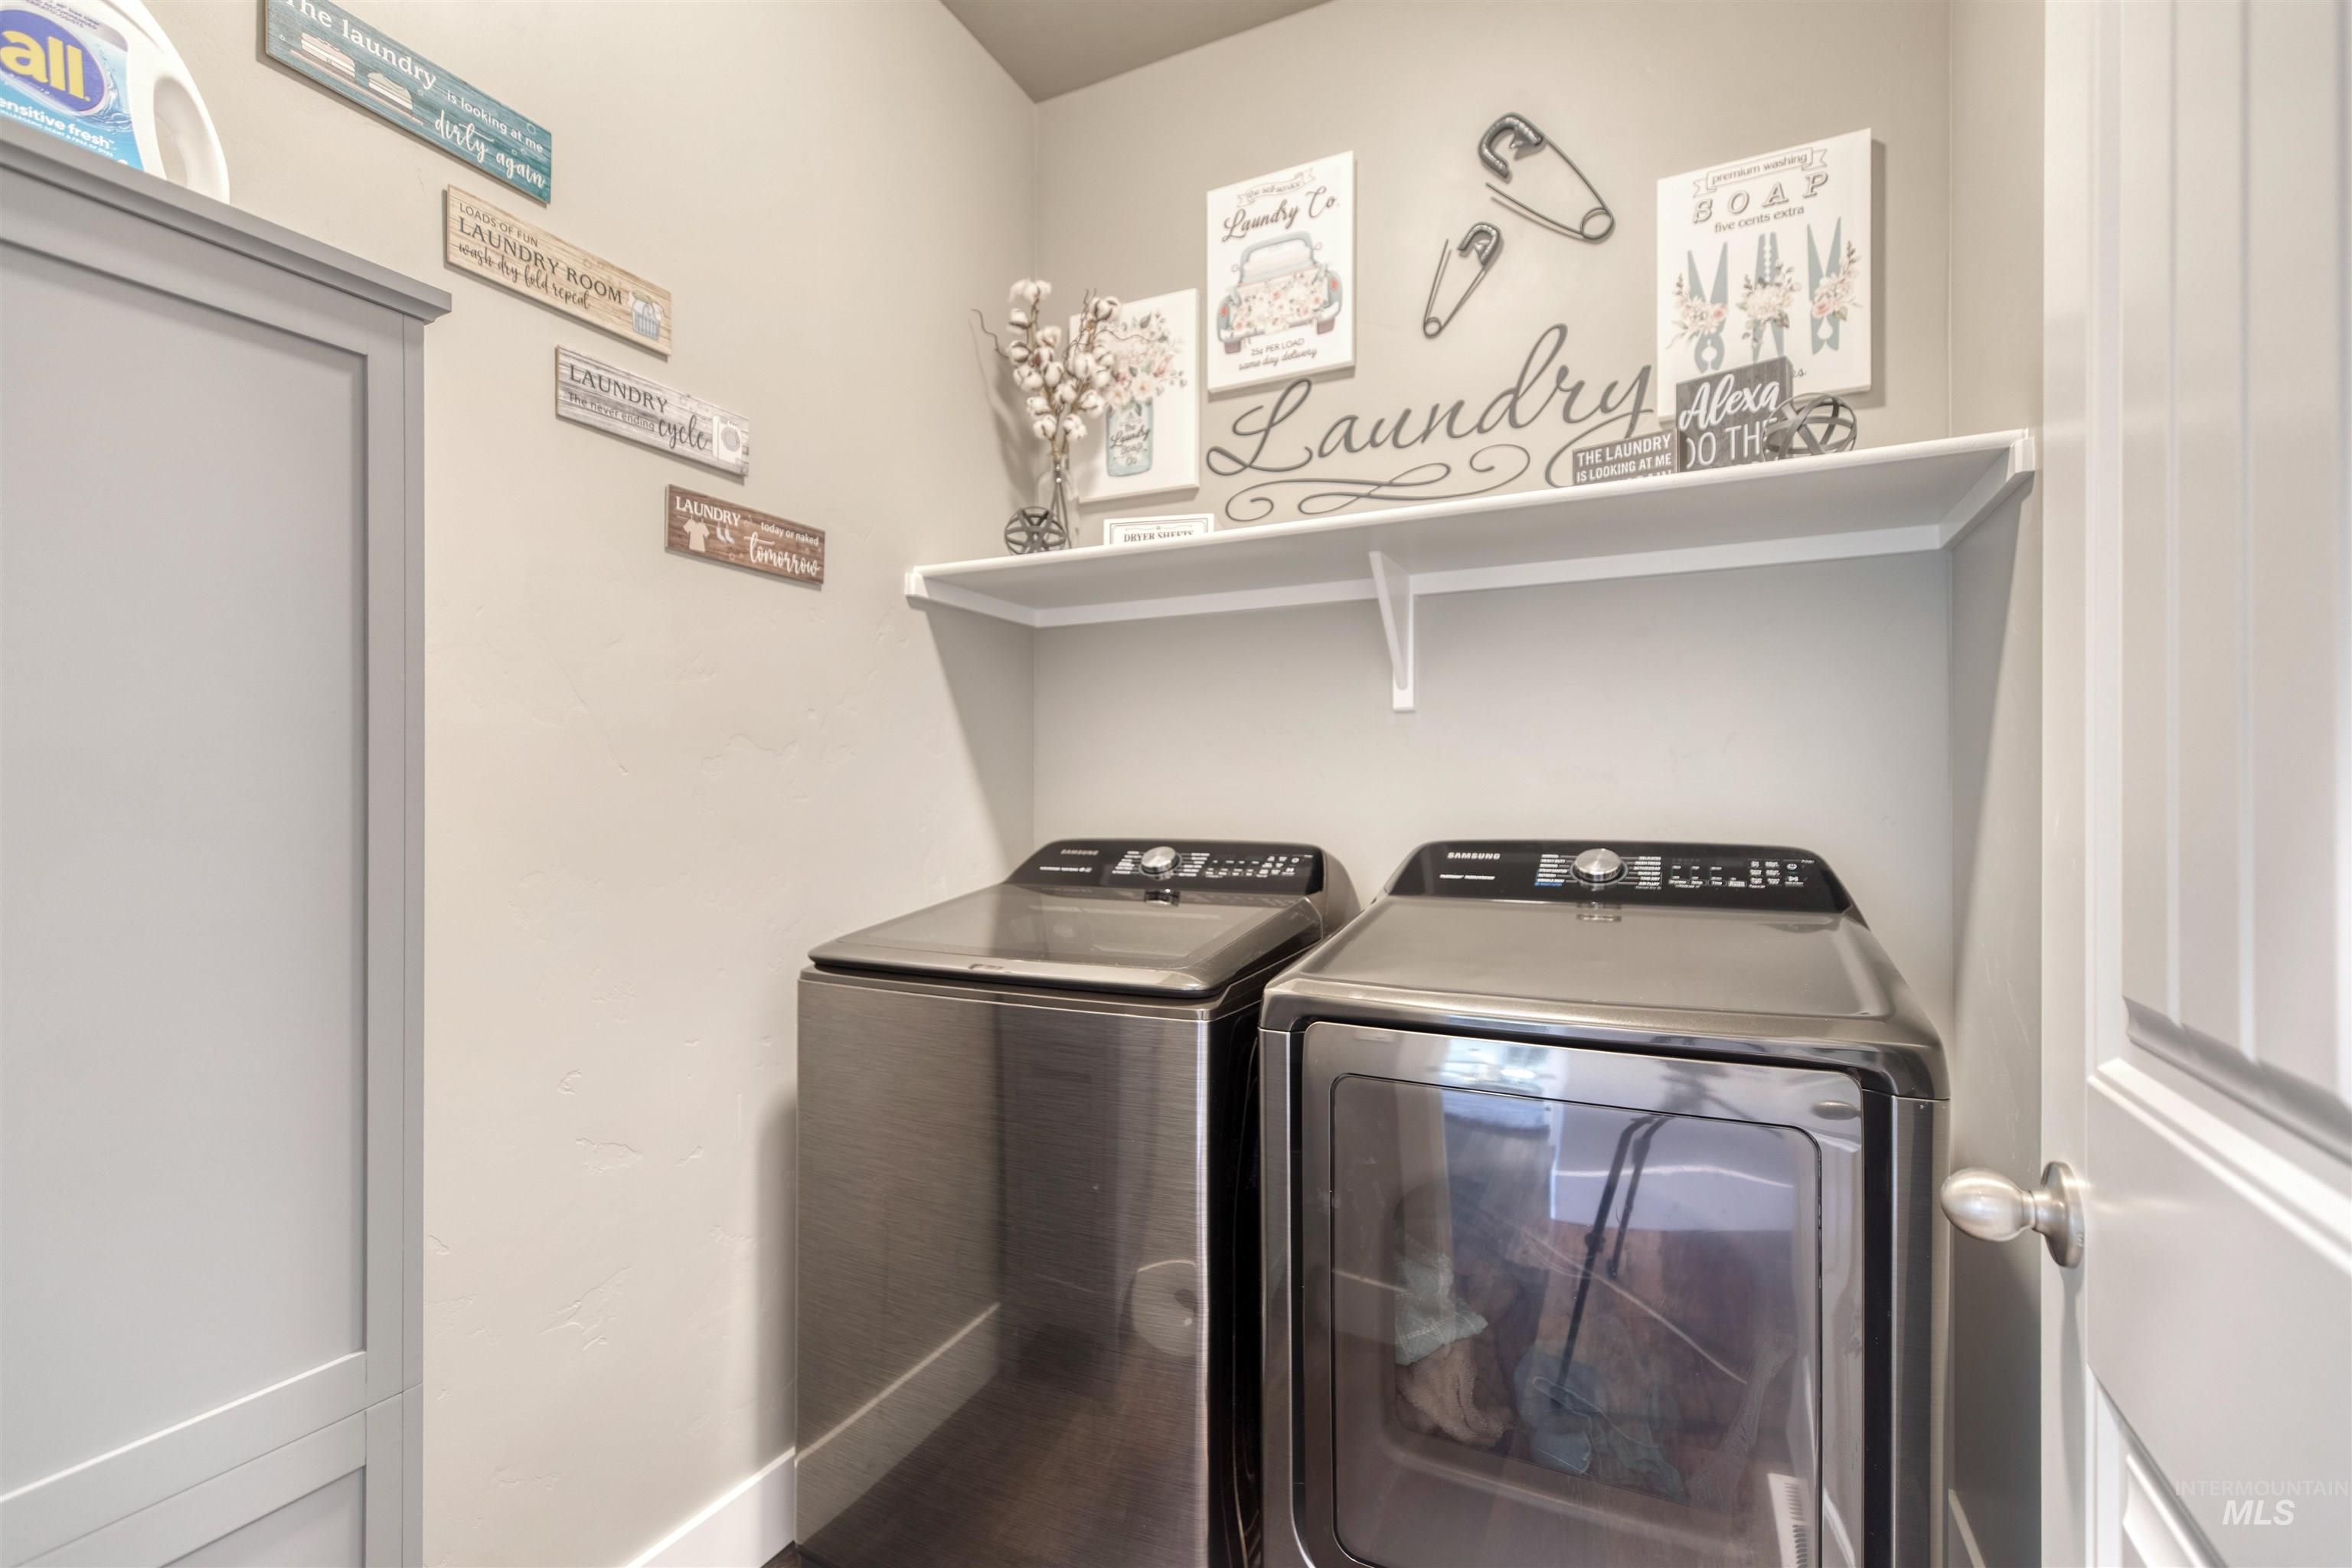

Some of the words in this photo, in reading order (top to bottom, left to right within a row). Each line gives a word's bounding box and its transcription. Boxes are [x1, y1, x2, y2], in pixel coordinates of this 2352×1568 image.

[0, 31, 86, 100] all
[341, 18, 437, 90] laundry
[447, 90, 458, 104] is
[461, 96, 508, 135] looking
[511, 126, 523, 143] at
[525, 136, 544, 152] me
[434, 109, 495, 164] dirty
[496, 150, 546, 189] again
[1711, 164, 1761, 185] premium
[1762, 152, 1808, 171] washing
[1693, 171, 1828, 224] SOAP
[1714, 219, 1736, 234] five
[1738, 211, 1771, 228] cents
[1773, 205, 1805, 220] extra
[459, 202, 497, 228] LOADS
[499, 220, 514, 234] OF
[517, 230, 538, 247] FUN
[1221, 198, 1300, 243] Laundry
[459, 216, 560, 274] LAUNDRY
[567, 266, 622, 305] ROOM
[459, 243, 495, 266] wash
[498, 254, 519, 283] dry
[524, 264, 548, 295] fold
[552, 283, 590, 309] repeat
[1239, 361, 1262, 371] same
[1263, 355, 1279, 368] day
[1281, 348, 1318, 362] delivery
[1266, 343, 1280, 353] PER
[1282, 338, 1305, 349] LOAD
[569, 364, 668, 413] LAUNDRY
[1205, 322, 1654, 488] Laundry
[1677, 373, 1780, 430] Alexa
[567, 390, 587, 407] The
[590, 400, 619, 418] never
[622, 410, 655, 433] ending
[658, 414, 711, 450] cycle
[1576, 470, 1587, 484] IS
[1589, 460, 1636, 482] LOOKING
[1638, 456, 1654, 470] AT
[1655, 452, 1672, 466] ME
[1577, 448, 1603, 468] THE
[1605, 433, 1672, 461] LAUNDRY
[675, 495, 741, 528] LAUNDRY
[760, 521, 784, 537] today
[786, 529, 795, 540] or
[796, 531, 819, 547] naked
[743, 531, 821, 577] tomorrow
[1123, 531, 1155, 543] DRYER
[1446, 851, 1501, 861] SAMSUNG
